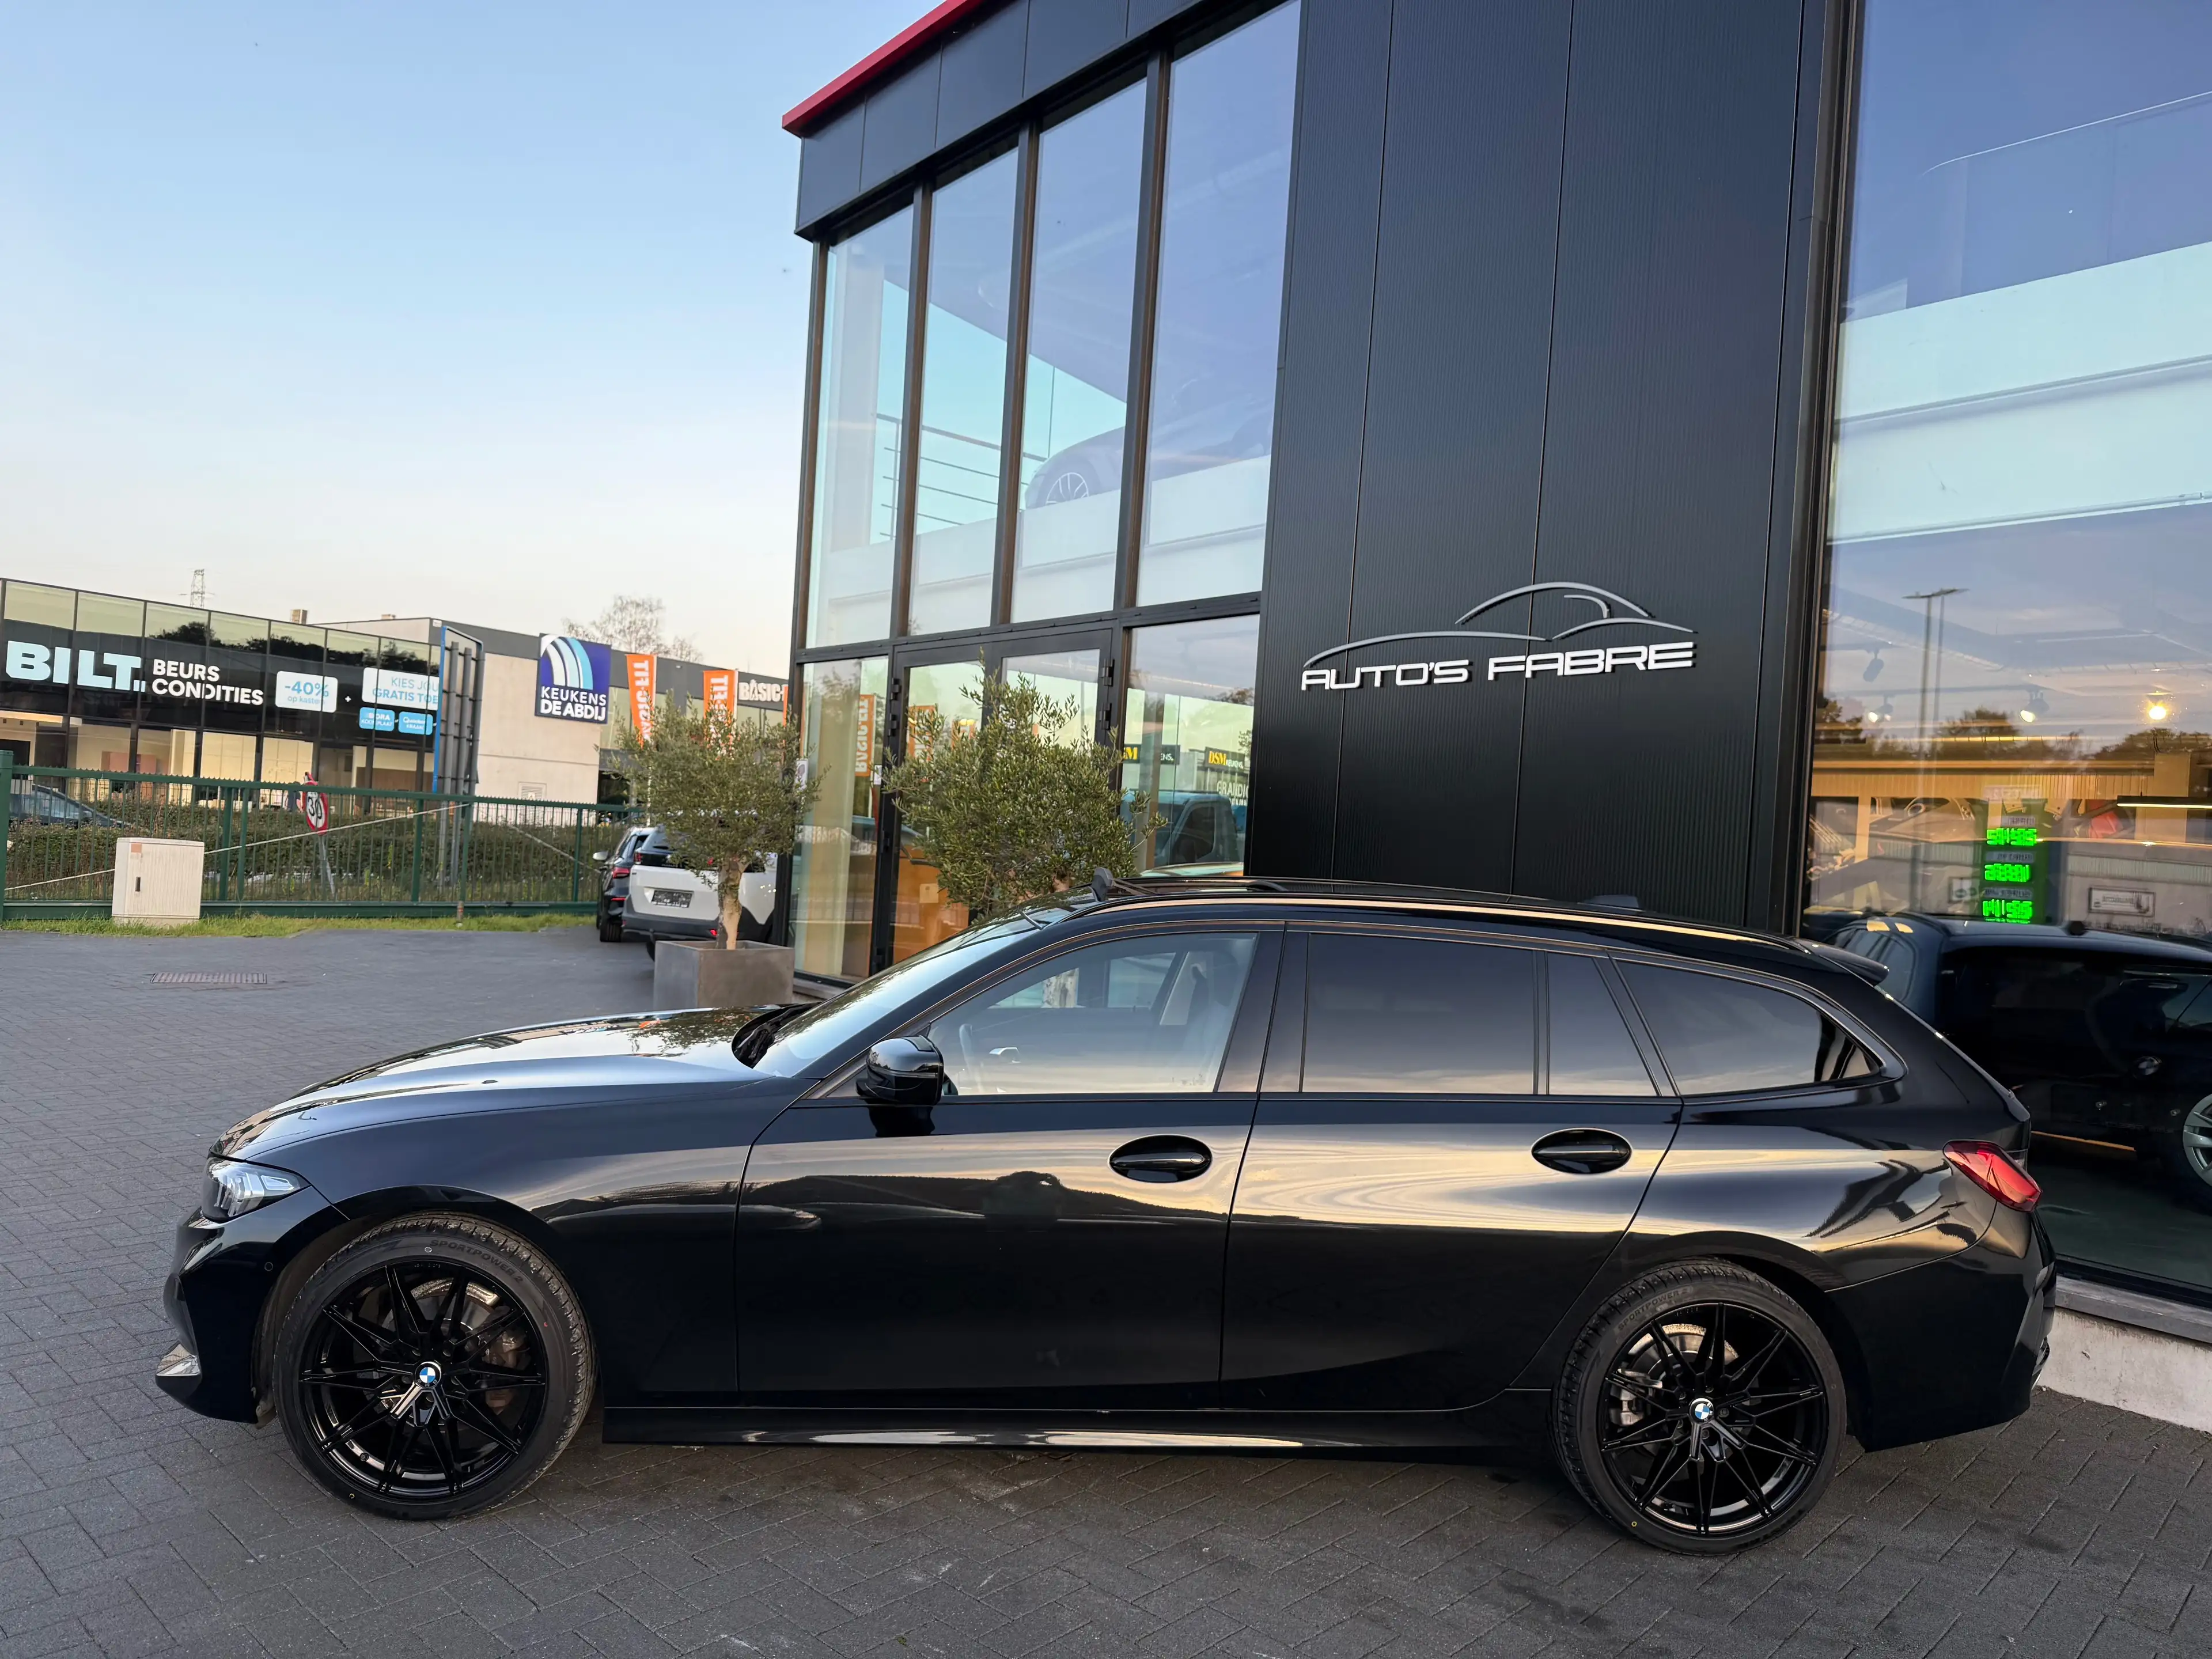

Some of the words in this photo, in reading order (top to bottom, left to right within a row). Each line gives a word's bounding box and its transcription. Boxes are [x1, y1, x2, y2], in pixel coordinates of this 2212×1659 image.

[6, 640, 146, 692] BILT.
[153, 659, 219, 682] BEURS
[1301, 660, 1469, 691] AUTO'S
[1488, 642, 1694, 680] FABRE
[152, 678, 263, 705] CONDITIES
[285, 681, 329, 697] -40%
[391, 676, 414, 690] KIES
[300, 696, 325, 704] kaste
[372, 688, 414, 702] GRATIS
[541, 686, 607, 706] KEUKENS
[540, 699, 562, 716] DE
[562, 702, 606, 721] ABDIJ
[1209, 751, 1226, 766] DSM
[308, 797, 323, 819] 30
[430, 1239, 516, 1277] SPORTPOWER
[1618, 1290, 1680, 1331] SPORTPOWER
